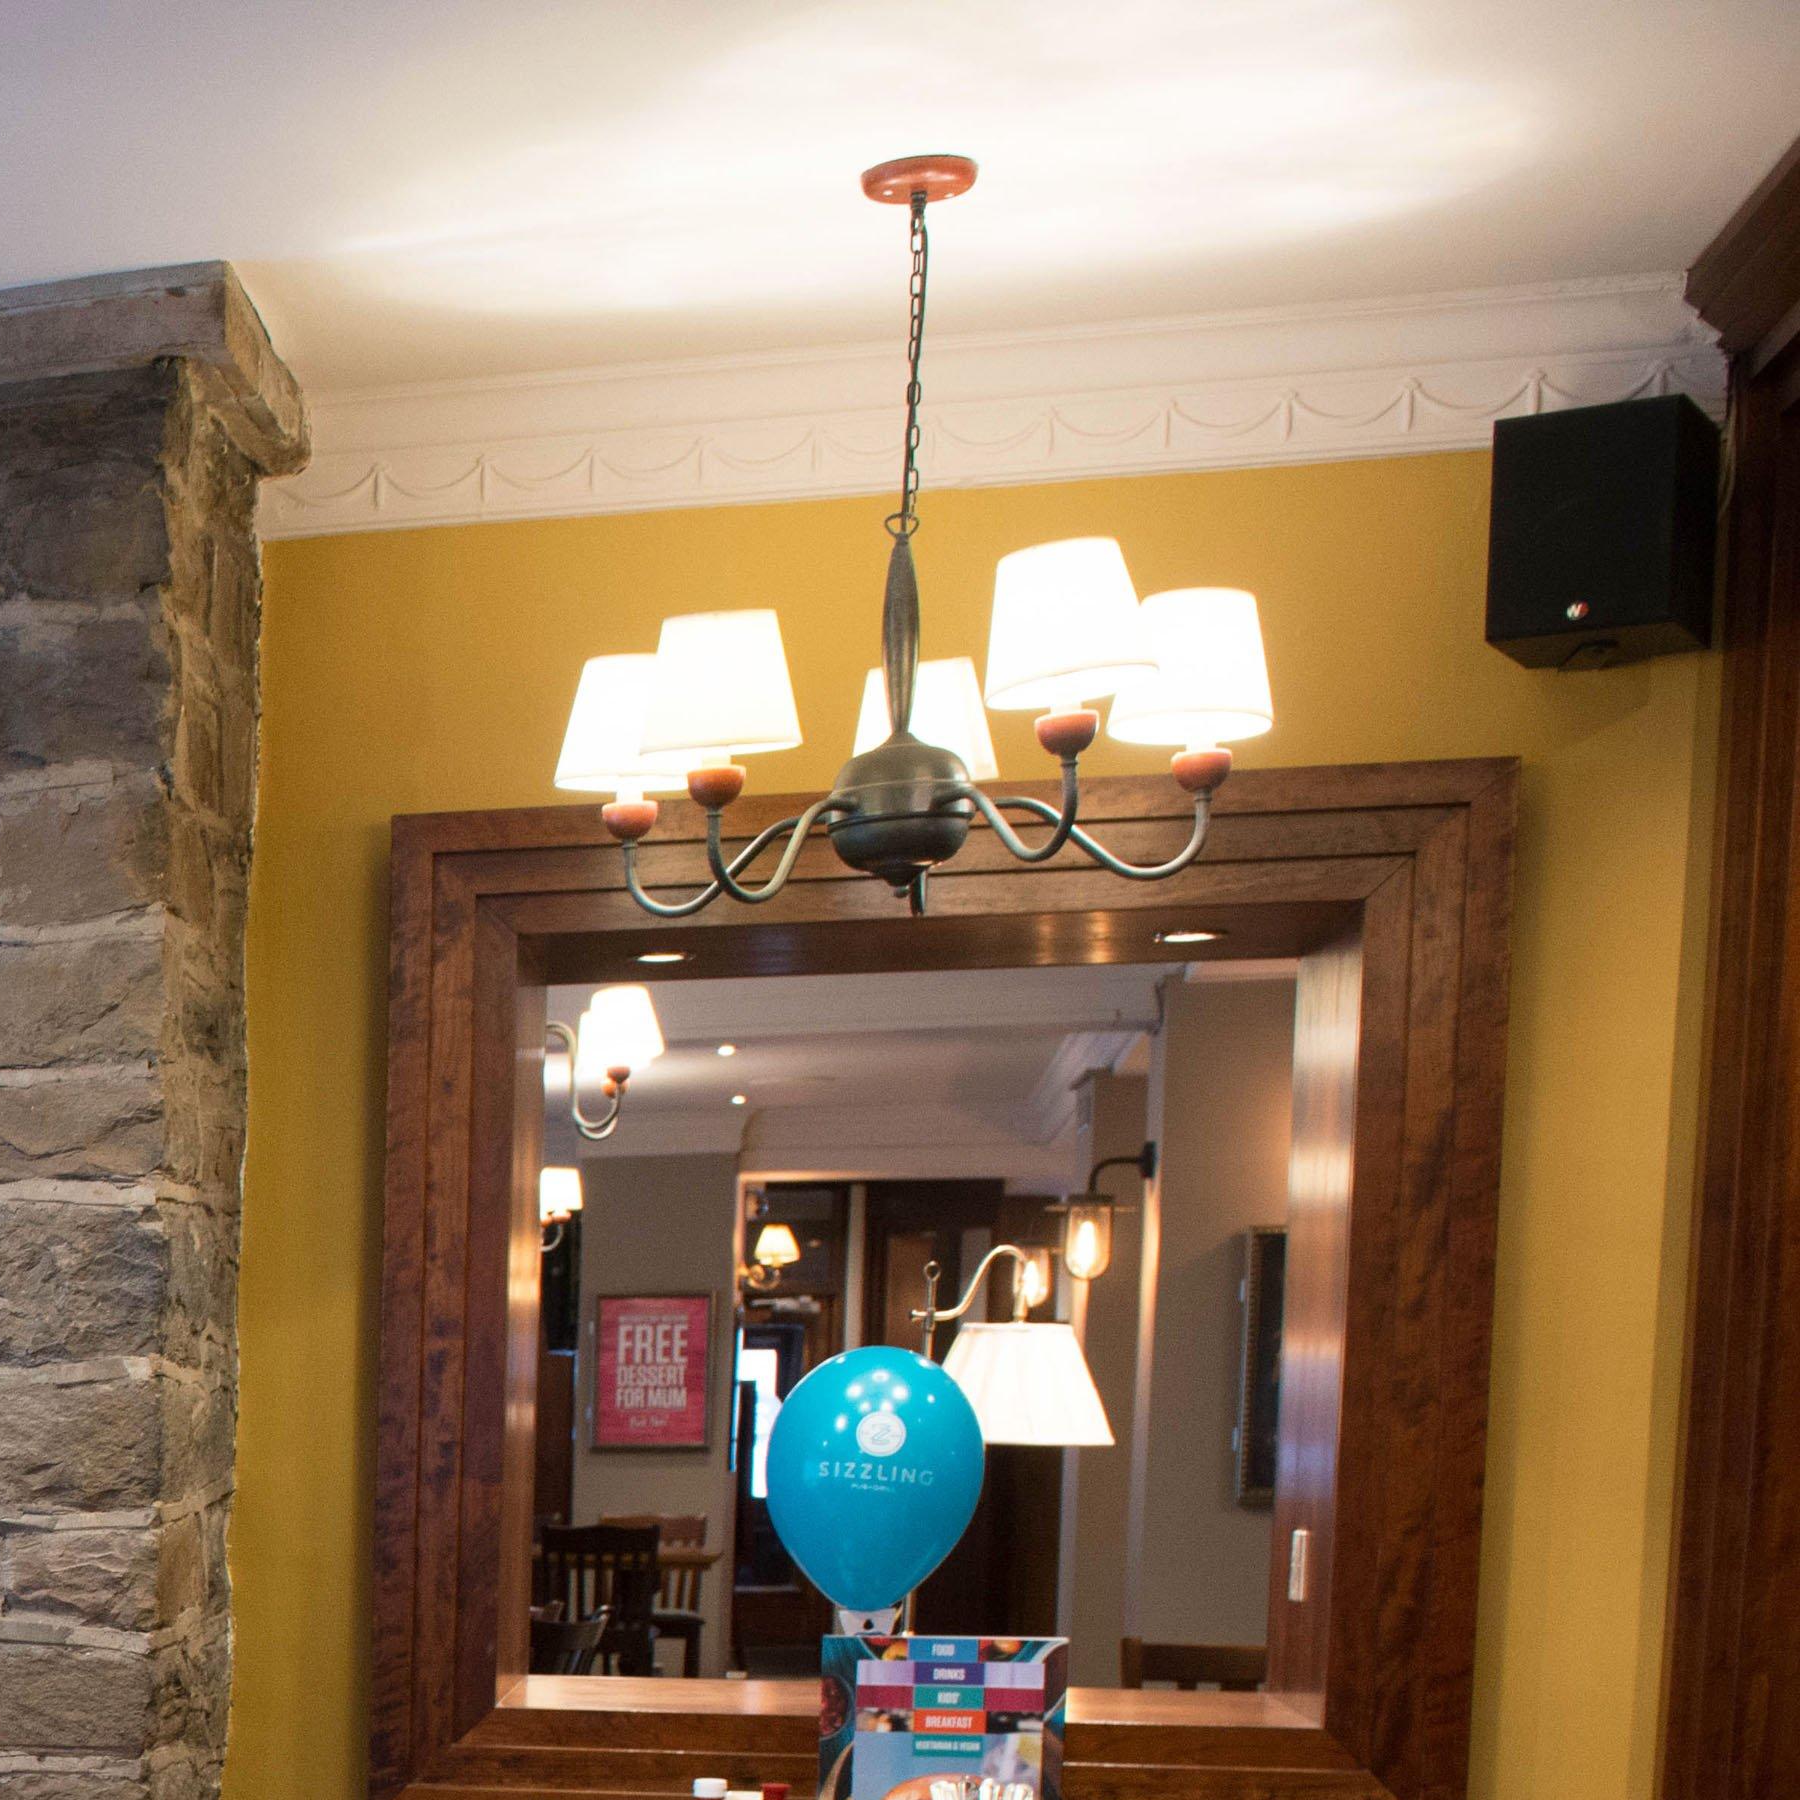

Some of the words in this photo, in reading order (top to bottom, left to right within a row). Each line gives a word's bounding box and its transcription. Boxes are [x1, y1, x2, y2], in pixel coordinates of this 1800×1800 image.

[618, 1324, 688, 1364] FREE
[616, 1364, 686, 1387] DESSERT
[615, 1387, 645, 1409] FOR
[647, 1387, 688, 1409] MUM
[819, 1461, 934, 1486] SIZZLING
[931, 1644, 955, 1656] FOOD
[933, 1668, 966, 1681] DRINKS
[925, 1716, 973, 1729] BREAKFAST
